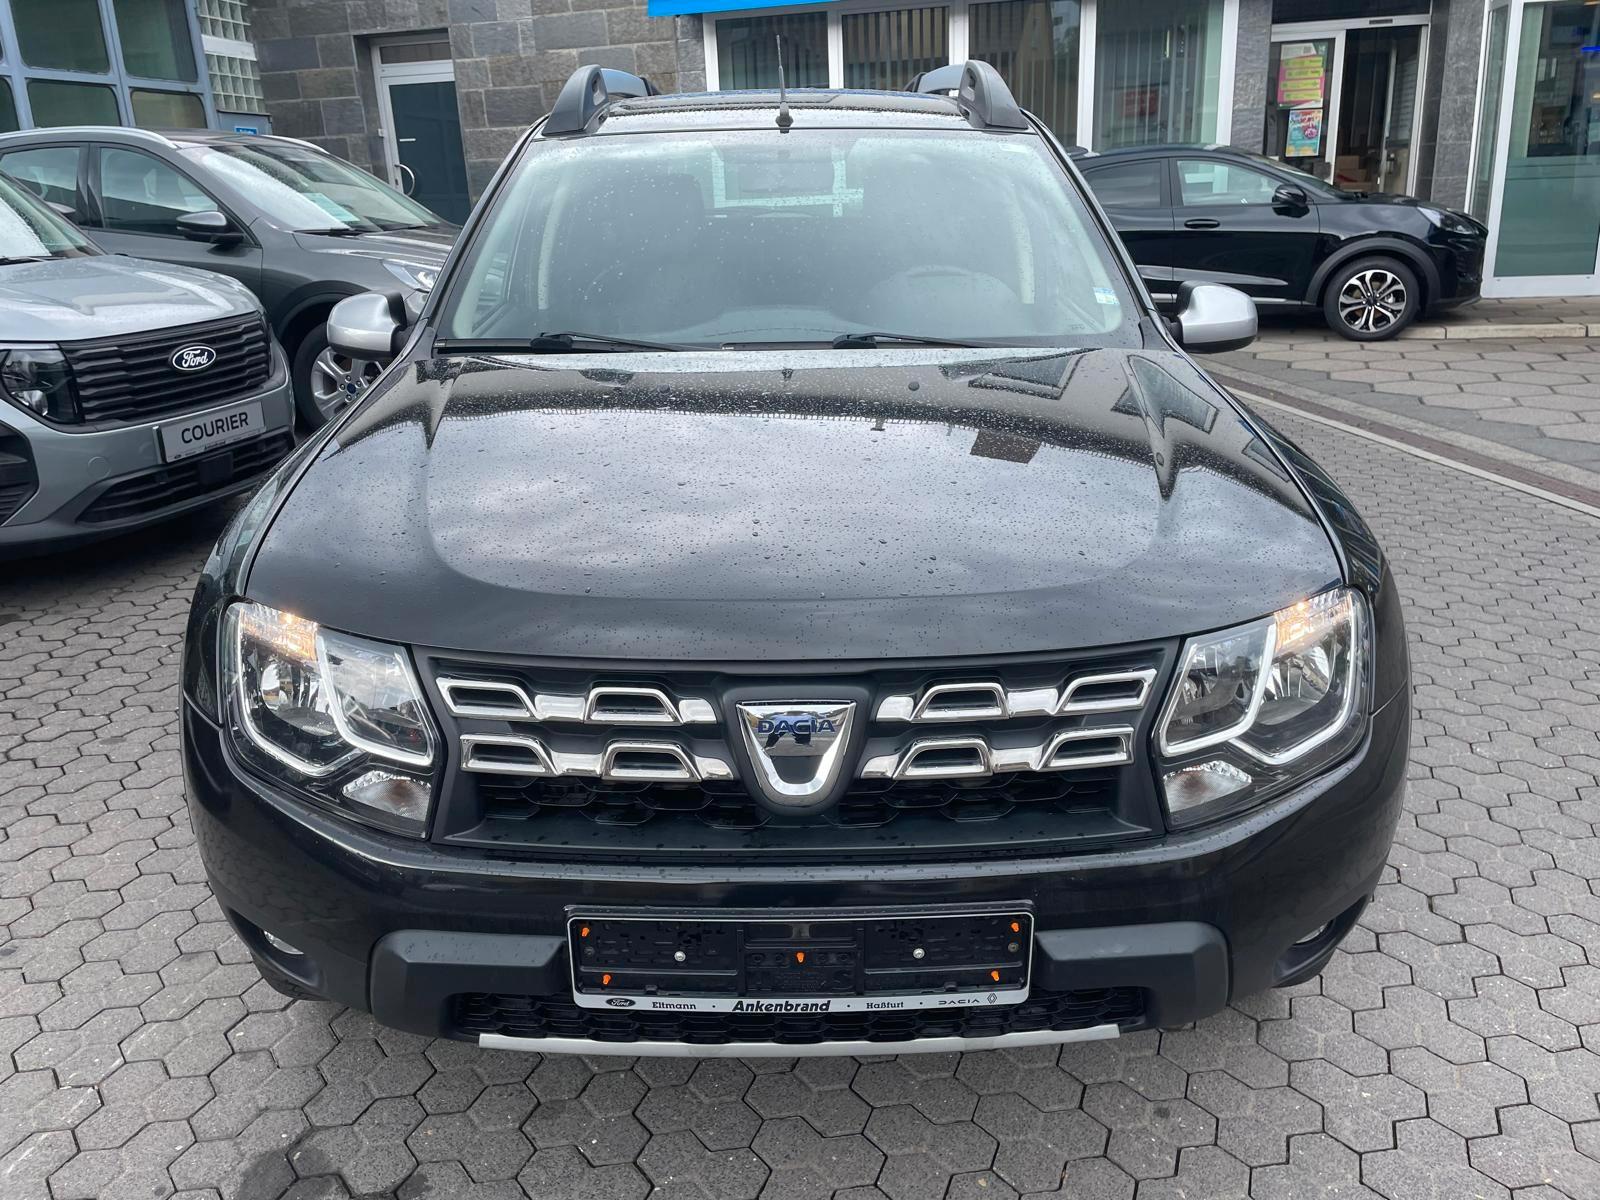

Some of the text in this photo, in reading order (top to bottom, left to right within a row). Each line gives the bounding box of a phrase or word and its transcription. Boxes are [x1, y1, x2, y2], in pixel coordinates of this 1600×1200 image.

[181, 349, 209, 368] Ford
[181, 411, 249, 444] COURIER
[757, 719, 836, 735] DACIA
[610, 998, 980, 1013] Ford Eltmann Ankenbrand Haßfurt DACIA
